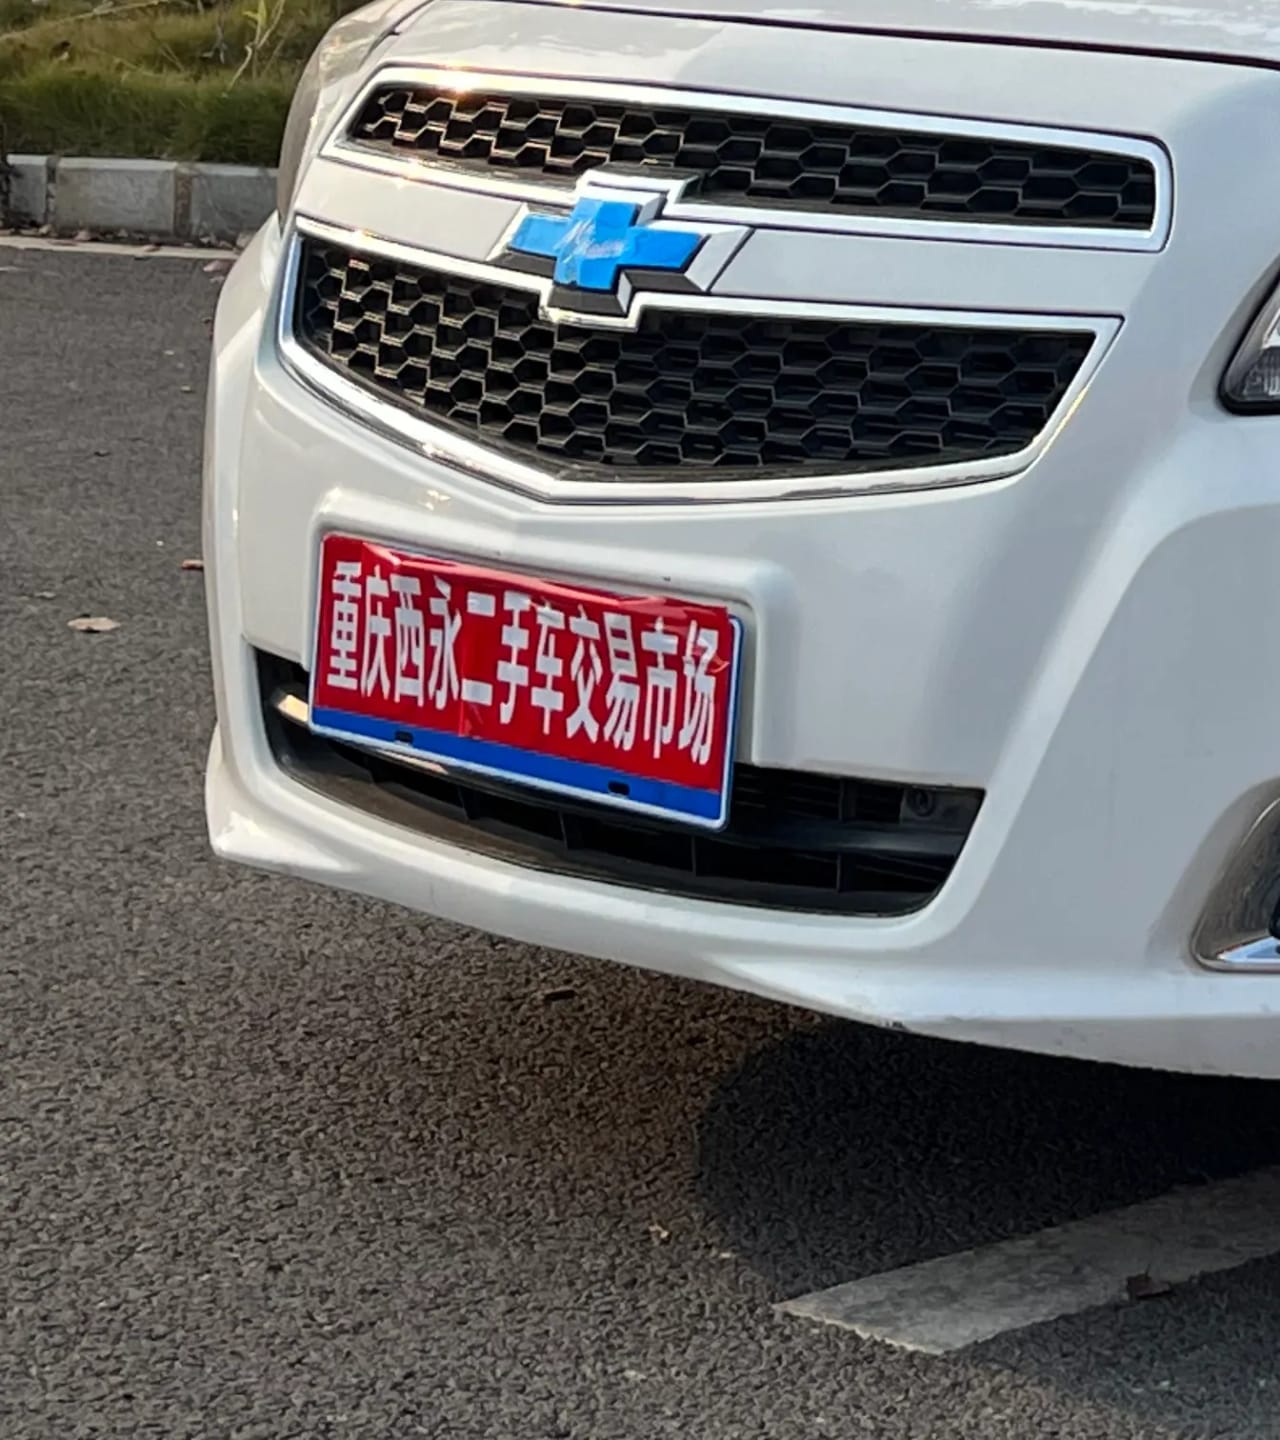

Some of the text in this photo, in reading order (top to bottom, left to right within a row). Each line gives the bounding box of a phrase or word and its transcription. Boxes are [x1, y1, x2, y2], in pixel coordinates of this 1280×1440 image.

[326, 561, 719, 766] 重庆西永二手车交易市场
